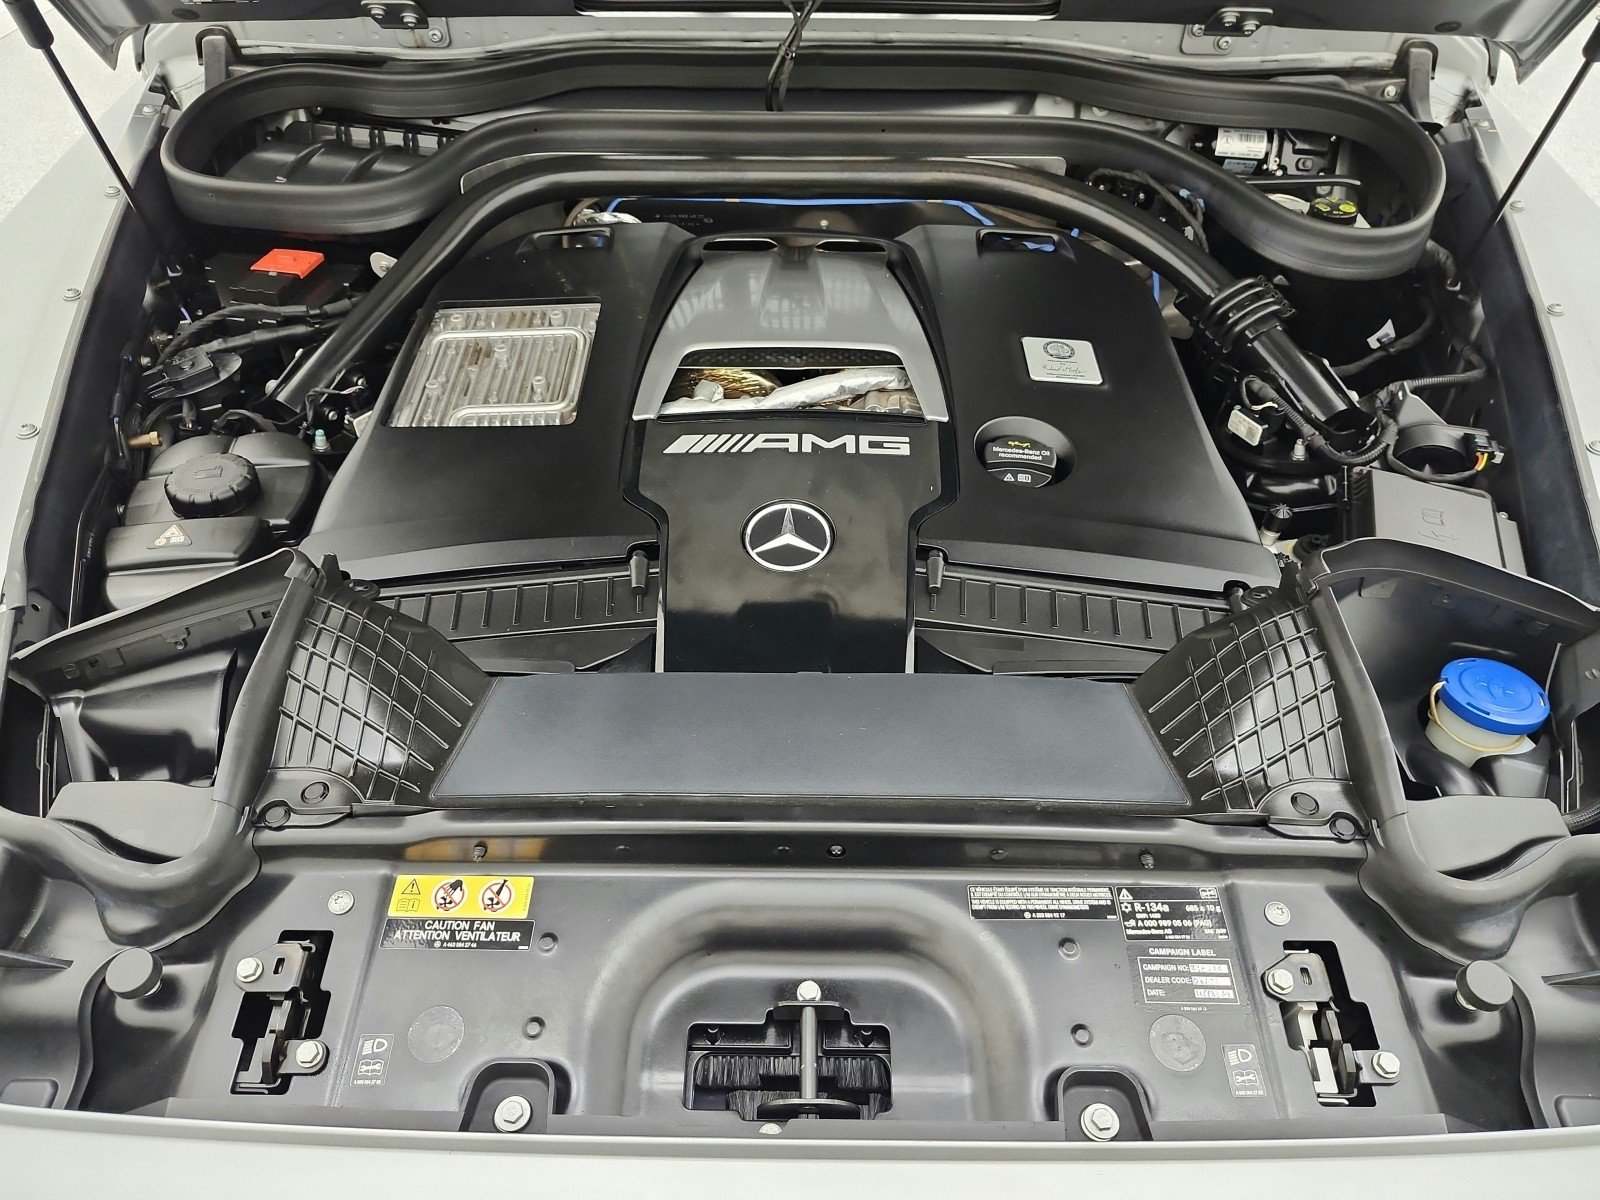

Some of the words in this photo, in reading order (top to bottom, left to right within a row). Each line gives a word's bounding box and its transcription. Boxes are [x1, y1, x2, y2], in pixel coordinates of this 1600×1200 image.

[741, 433, 910, 456] AMG
[992, 446, 1040, 456] Mercedes-Benz
[998, 452, 1042, 460] recommended
[1133, 902, 1169, 912] R-134a
[424, 920, 470, 931] CAUTION
[473, 920, 495, 931] FAN
[393, 930, 450, 941] ATTENTION
[455, 930, 521, 941] VENTILATEUR
[1149, 948, 1190, 957] CAMPAIGN
[1191, 949, 1216, 957] LABEL
[1142, 963, 1176, 971] CAMPAIGN
[1177, 963, 1189, 971] NO:
[1145, 976, 1170, 984] DEALER
[1171, 976, 1192, 984] CODE:
[1147, 988, 1166, 996] DATE:
